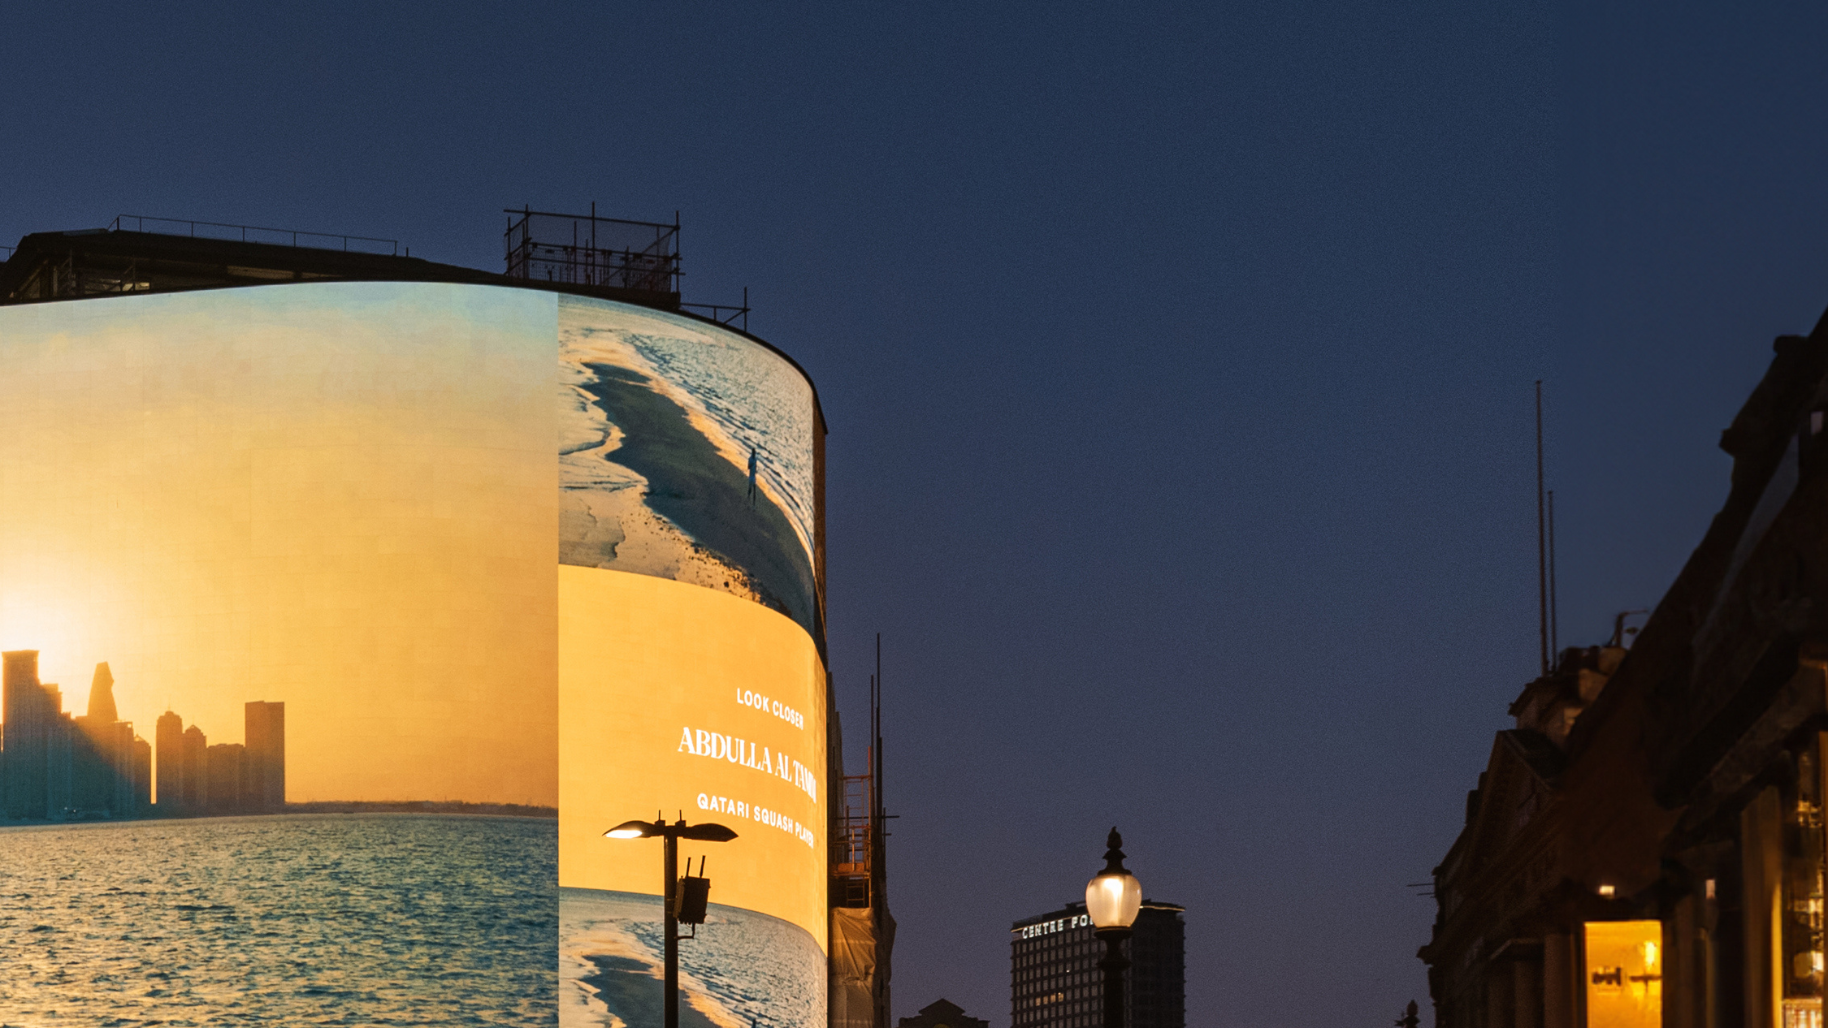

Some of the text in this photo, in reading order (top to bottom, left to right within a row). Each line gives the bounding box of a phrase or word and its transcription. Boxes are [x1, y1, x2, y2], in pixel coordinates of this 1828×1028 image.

[736, 687, 804, 731] LOOK CLOSER
[677, 726, 772, 775] ABDULLA
[774, 751, 792, 782] AL
[697, 792, 814, 849] QATARI SQUASH PLAYER
[1022, 919, 1064, 940] CENTRE
